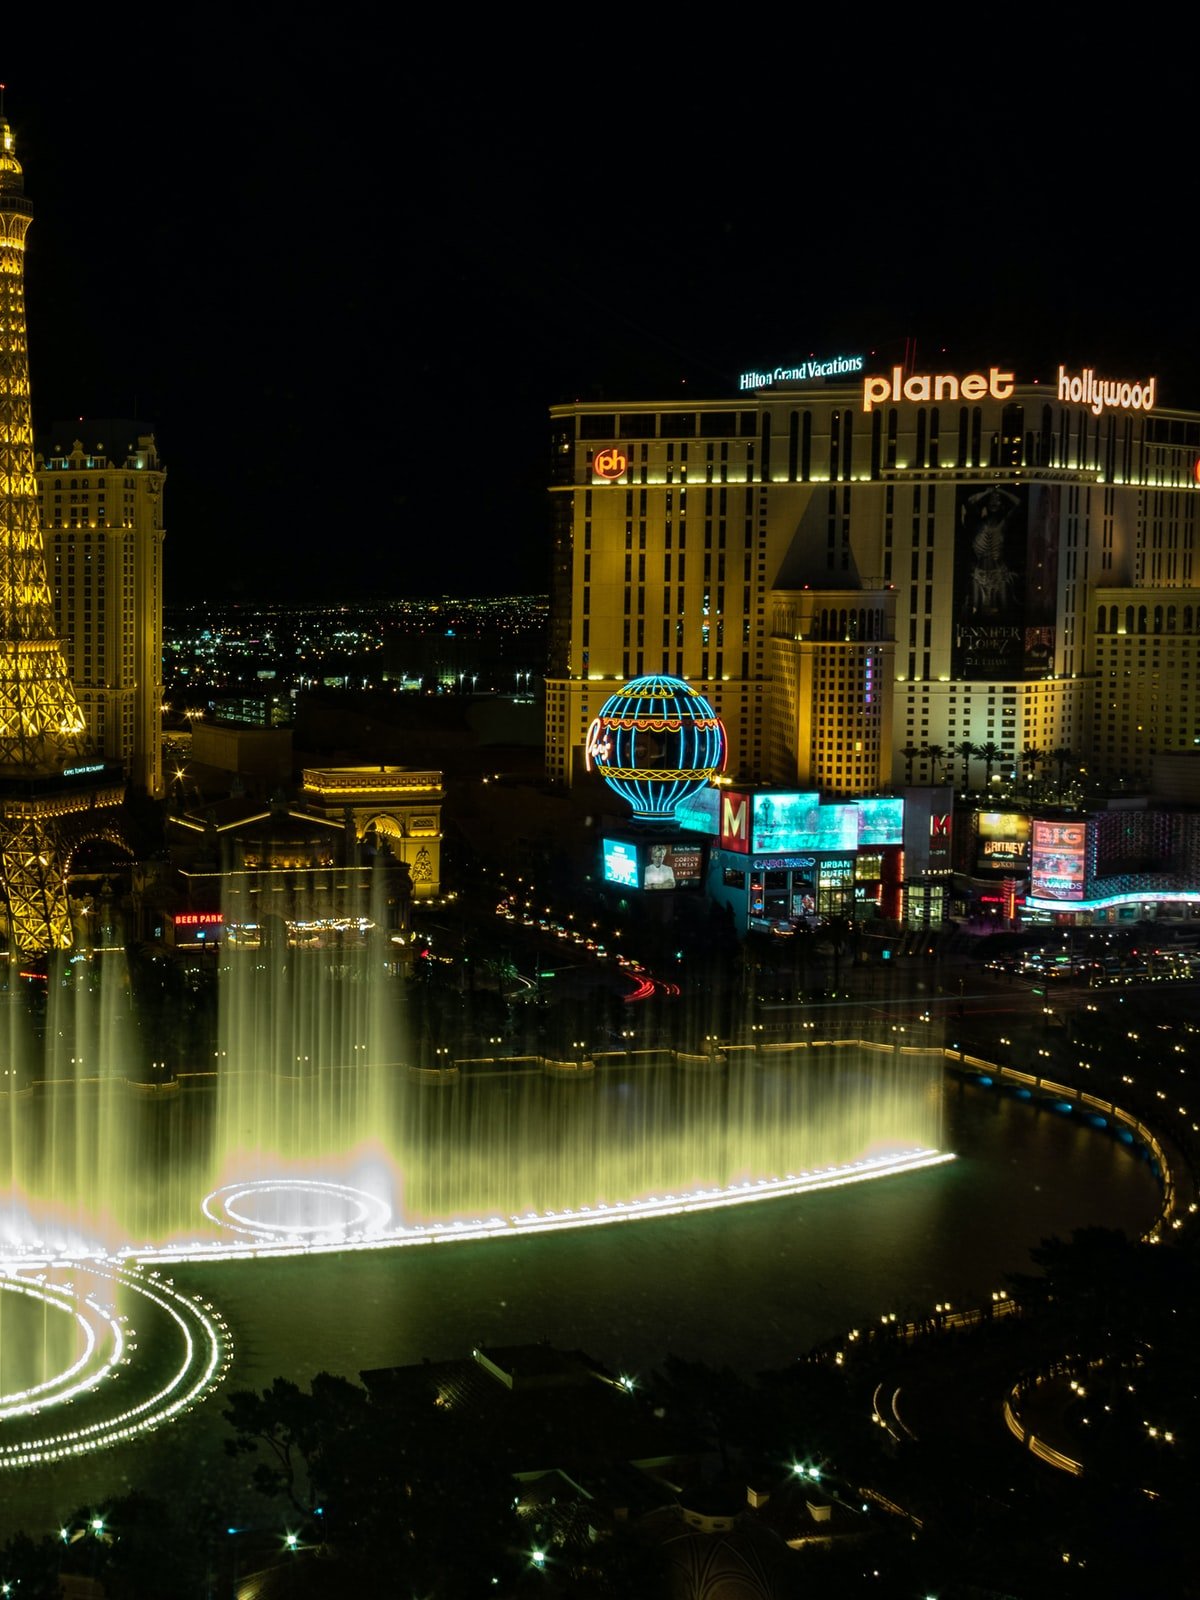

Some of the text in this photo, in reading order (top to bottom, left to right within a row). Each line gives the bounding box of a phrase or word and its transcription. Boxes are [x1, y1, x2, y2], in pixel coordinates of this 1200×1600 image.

[740, 355, 862, 390] Hilton Grand Vacations
[863, 366, 1014, 412] planet
[1058, 365, 1155, 414] hollywood
[599, 449, 626, 474] ph
[723, 797, 746, 840] M
[984, 841, 1025, 856] BRITNEY
[820, 860, 851, 869] URBAN
[1032, 879, 1083, 890] REWARDS
[175, 914, 223, 924] BEER PARK
